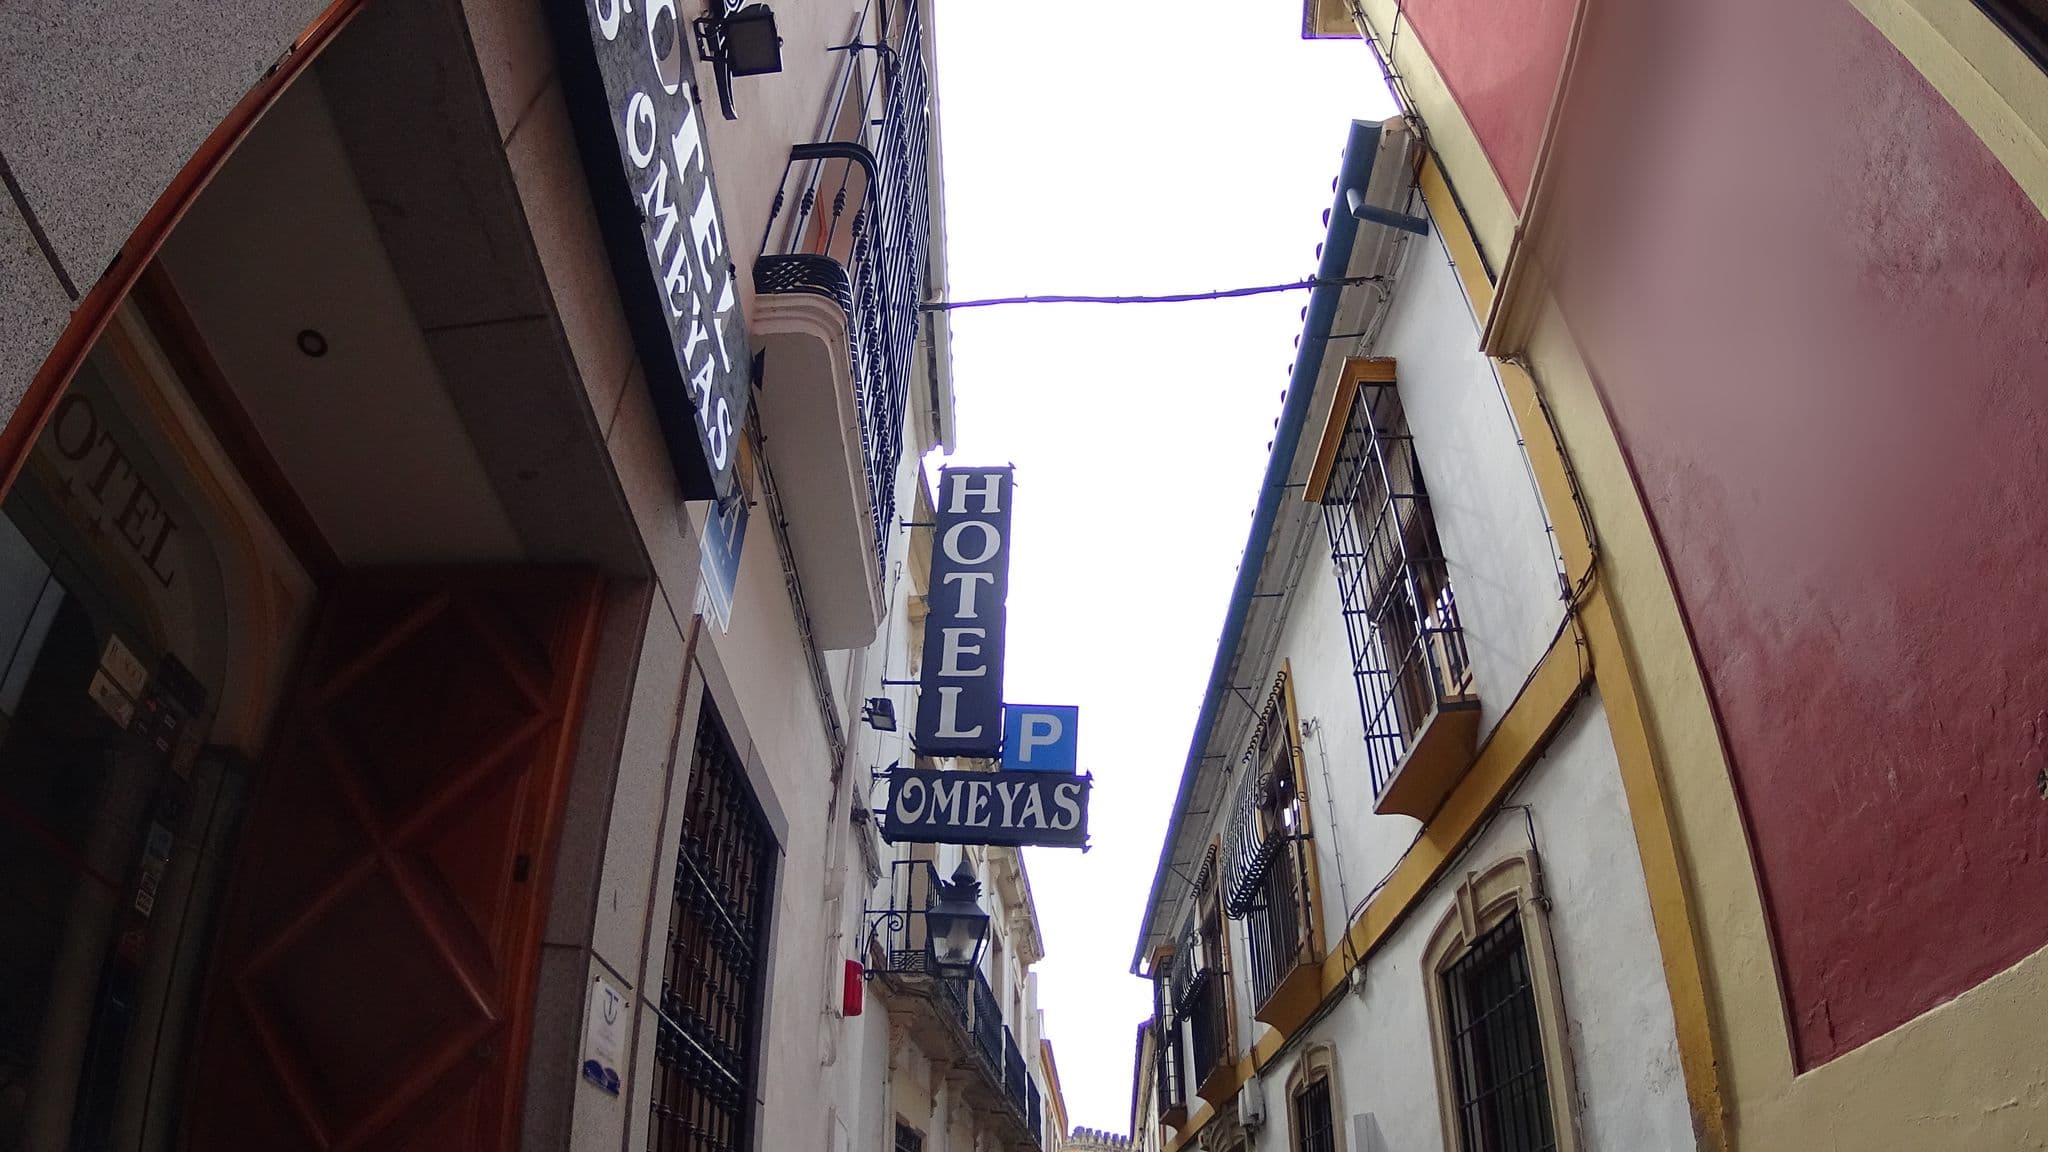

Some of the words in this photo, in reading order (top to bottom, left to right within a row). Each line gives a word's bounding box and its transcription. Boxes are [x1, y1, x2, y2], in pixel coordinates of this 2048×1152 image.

[934, 473, 1003, 739] HOTEL
[1018, 712, 1064, 763] P
[895, 775, 1082, 832] OMEYAS
